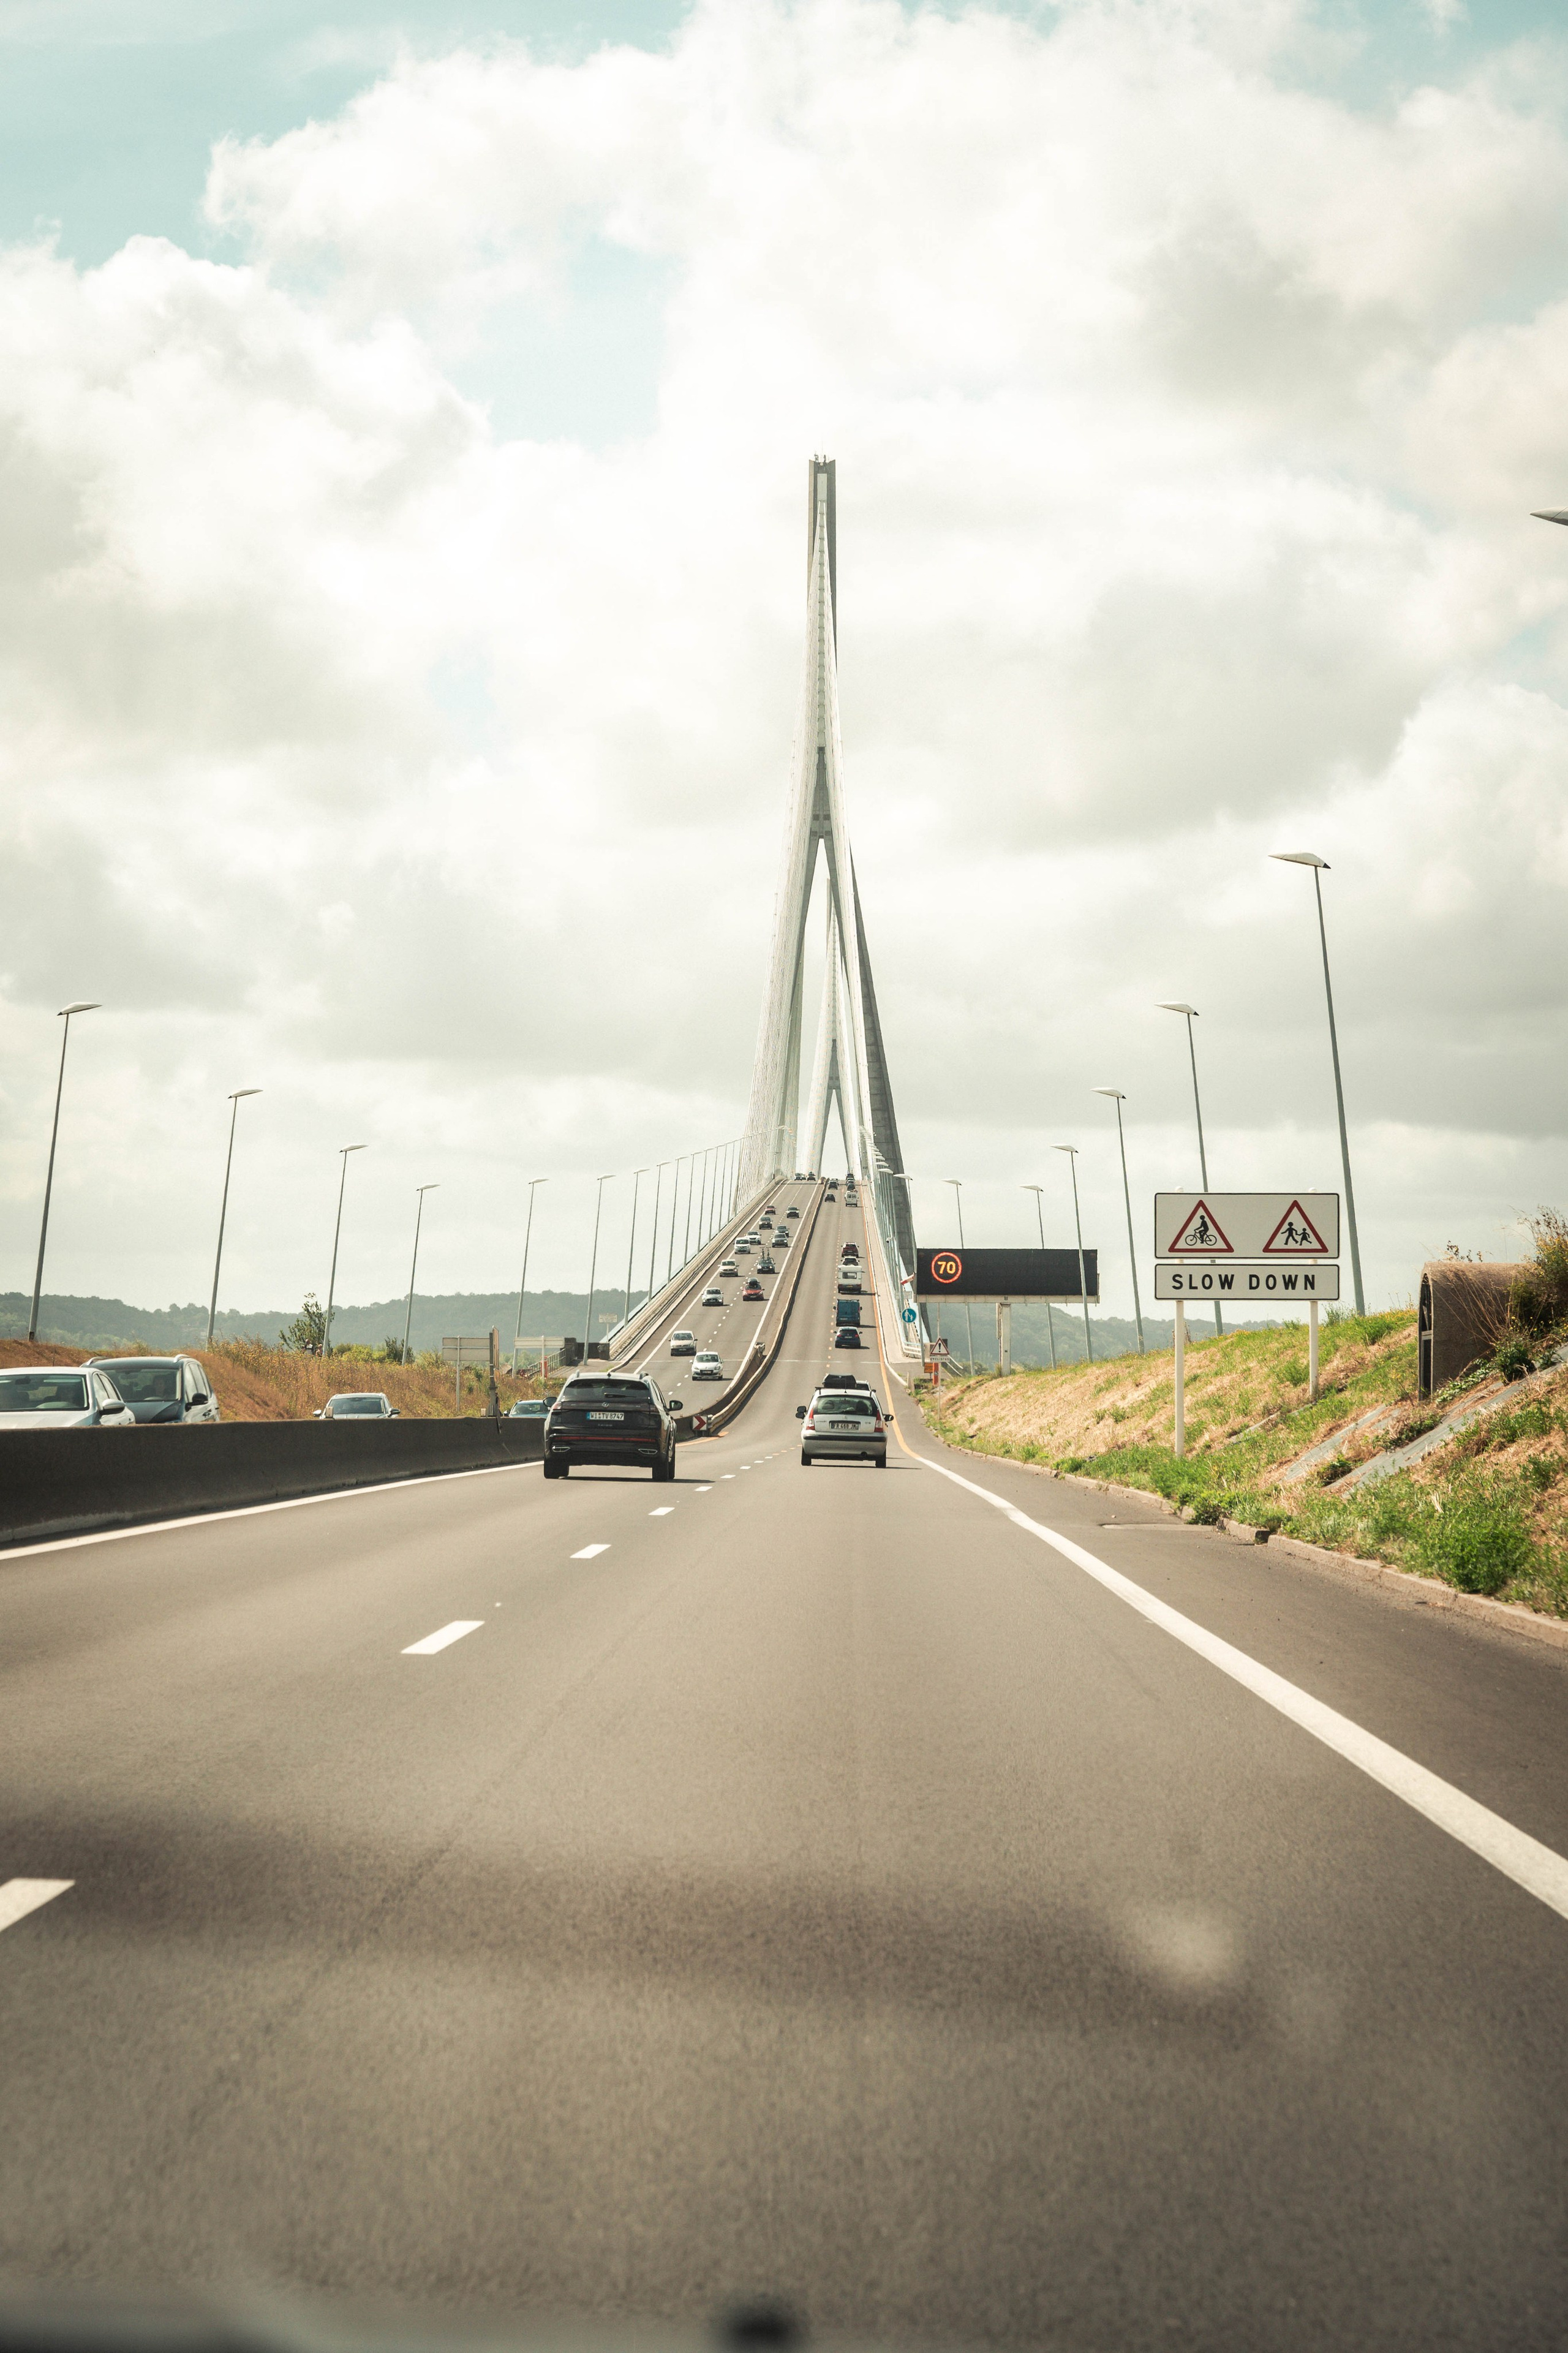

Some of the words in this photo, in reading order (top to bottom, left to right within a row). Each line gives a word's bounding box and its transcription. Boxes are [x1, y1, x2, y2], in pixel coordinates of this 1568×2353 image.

[937, 1261, 956, 1274] 70
[1172, 1274, 1235, 1290] SLOW
[1249, 1274, 1315, 1290] DOWN
